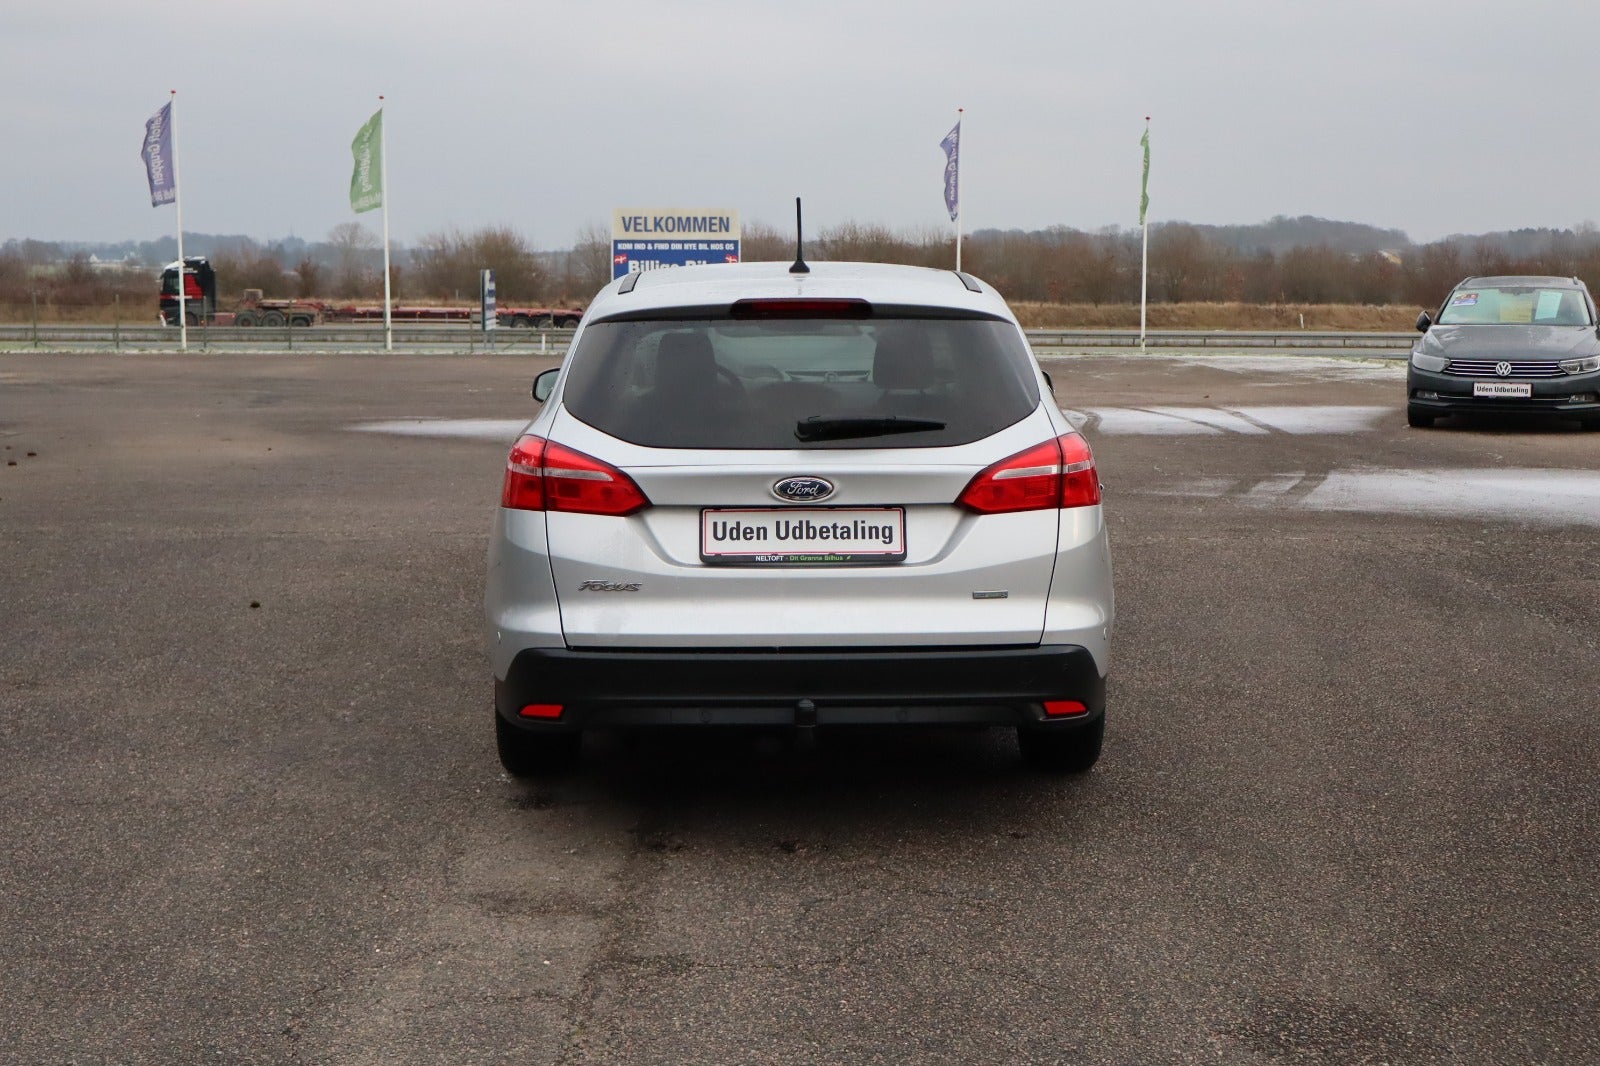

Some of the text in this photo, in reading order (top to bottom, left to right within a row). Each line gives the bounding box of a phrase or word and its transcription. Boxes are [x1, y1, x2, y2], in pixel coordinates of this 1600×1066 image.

[622, 217, 730, 232] VELKOMMEN
[1494, 386, 1529, 394] Udbetaling
[787, 481, 819, 496] Ford
[712, 519, 894, 544] Uden Udbetaling
